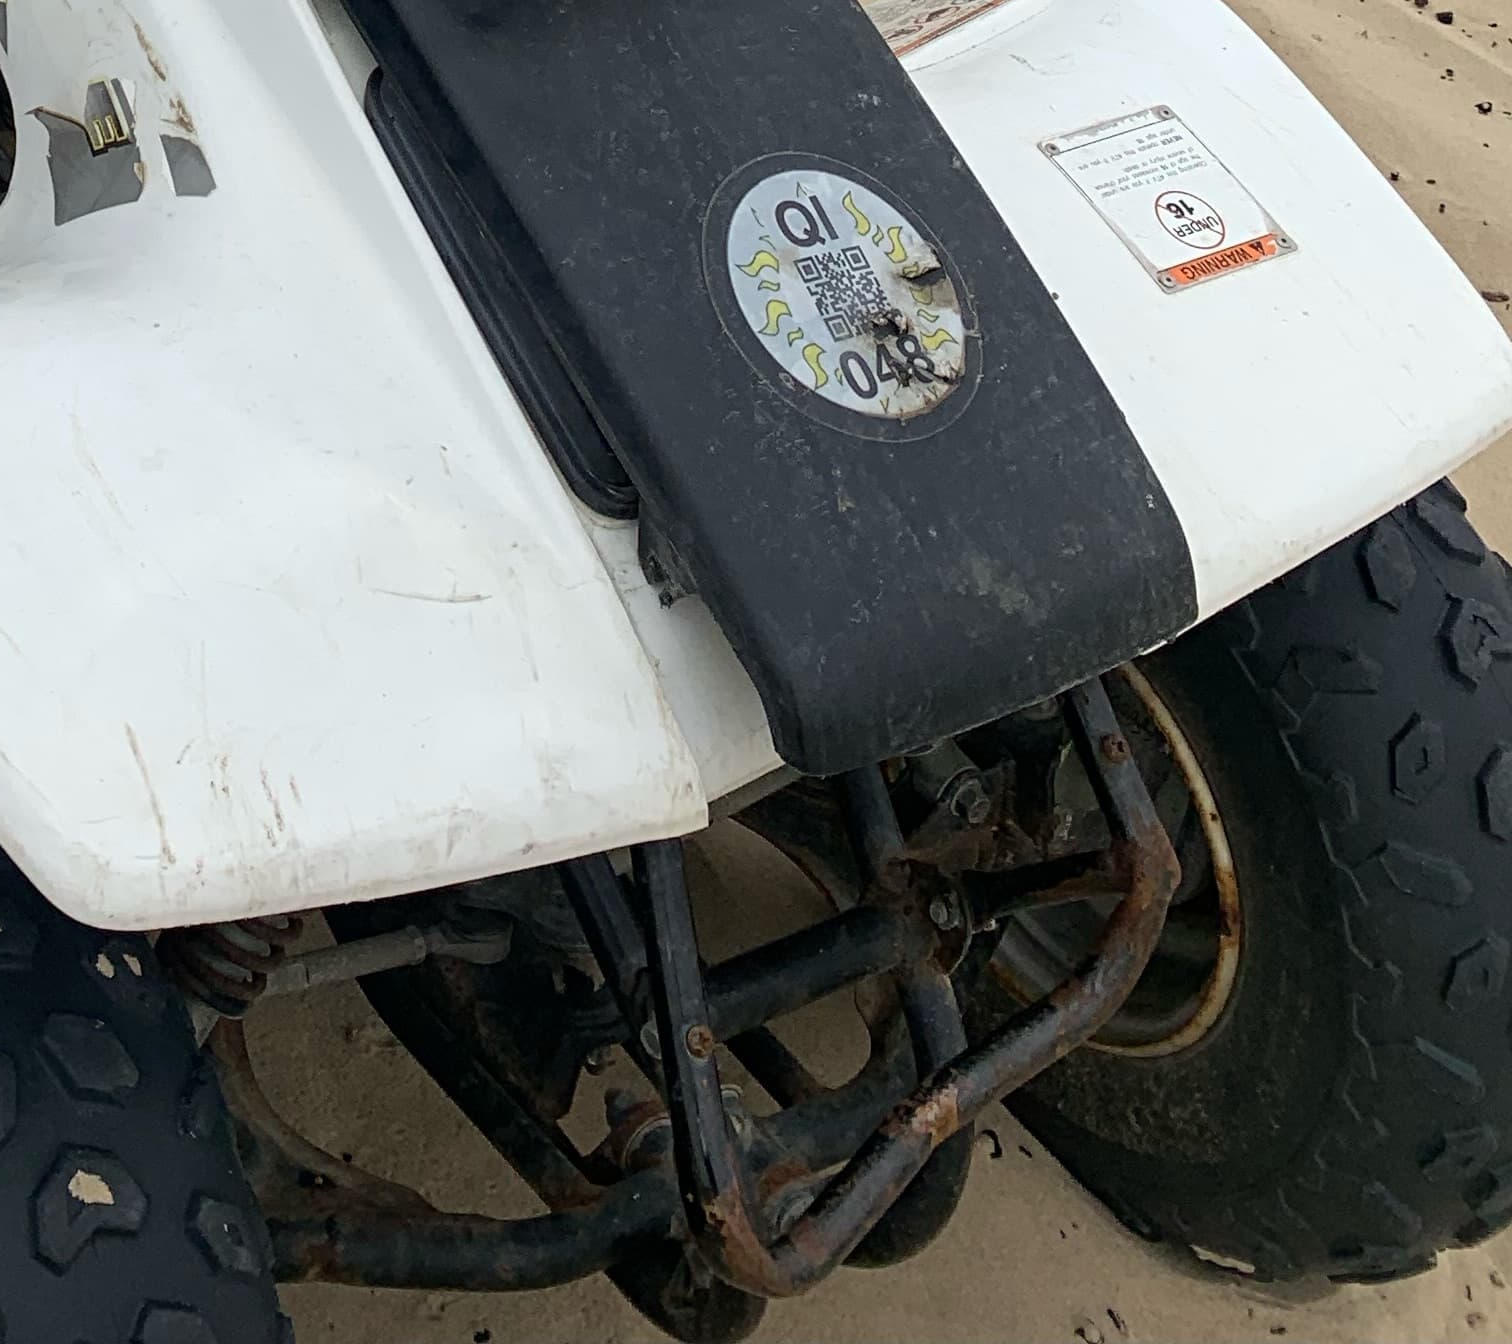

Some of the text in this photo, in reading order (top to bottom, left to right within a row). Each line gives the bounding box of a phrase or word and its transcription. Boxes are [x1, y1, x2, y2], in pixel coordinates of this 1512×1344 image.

[774, 195, 839, 249] QI
[1165, 199, 1195, 220] 16
[1172, 215, 1220, 238] UNDER
[1180, 247, 1253, 281] WARNING
[839, 333, 935, 399] 048
